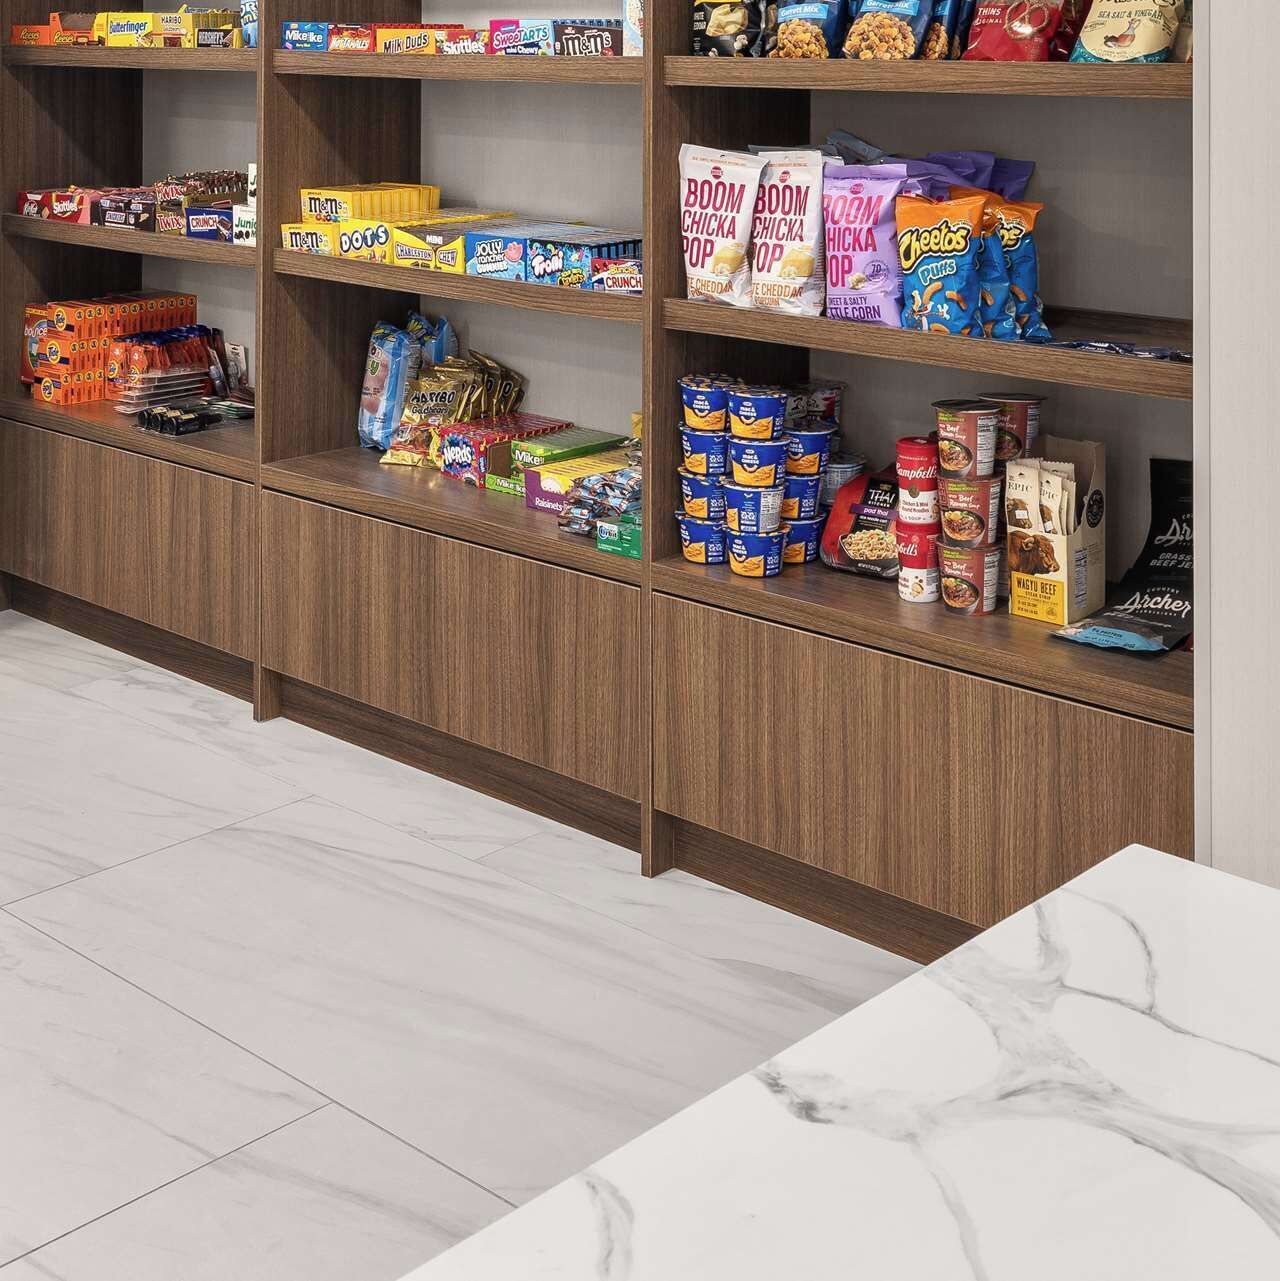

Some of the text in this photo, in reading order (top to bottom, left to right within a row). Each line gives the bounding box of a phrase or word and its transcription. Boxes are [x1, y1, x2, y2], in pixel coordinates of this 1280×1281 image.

[978, 7, 1001, 16] THINS
[1098, 10, 1109, 19] SEA
[1111, 10, 1126, 19] SALT
[1134, 9, 1163, 20] VINEGAR
[109, 19, 148, 35] Butterfinger
[161, 14, 182, 25] HARIBO
[286, 29, 323, 43] Mike Ike
[384, 32, 429, 53] Milk Duds
[444, 39, 485, 55] Skittles
[684, 178, 746, 214] BOOM
[754, 183, 810, 217] BOOM
[53, 200, 78, 215] Skittles
[823, 194, 883, 226] BOOM
[191, 216, 218, 229] CRUNCH
[682, 209, 736, 240] CHICKA
[752, 215, 804, 242] CHICKA
[341, 224, 388, 252] DOTS
[426, 235, 443, 245] MINI
[827, 226, 877, 252] HICKA
[476, 240, 503, 255] JOLLY
[682, 235, 715, 269] POP
[899, 222, 970, 270] Cheetos
[396, 244, 457, 265] CHARLESTON CHEW
[477, 252, 505, 265] rancher
[752, 241, 784, 273] POP
[531, 250, 564, 277] Trolli
[827, 254, 852, 287] OP
[871, 264, 882, 272] 70
[919, 259, 957, 286] Puffs
[606, 276, 642, 289] CRUNCH
[696, 276, 733, 294] CHEDDAR
[761, 282, 803, 297] CHEDDAR
[849, 296, 867, 307] SALTY
[830, 306, 881, 320] TTLE CORN
[24, 325, 48, 338] bounce
[410, 391, 456, 404] HARIBO
[946, 424, 960, 433] Beef
[515, 450, 540, 465] Mike
[496, 478, 513, 489] Mike
[1008, 481, 1032, 494] EPIC
[869, 489, 896, 503] THAI
[958, 494, 974, 503] Beef
[535, 496, 563, 512] Raisinets
[877, 508, 889, 517] thai
[952, 562, 967, 571] Beef
[1150, 559, 1176, 567] BEEF
[1016, 576, 1057, 596] WAGYU BEEF
[1113, 591, 1192, 618] Archer
